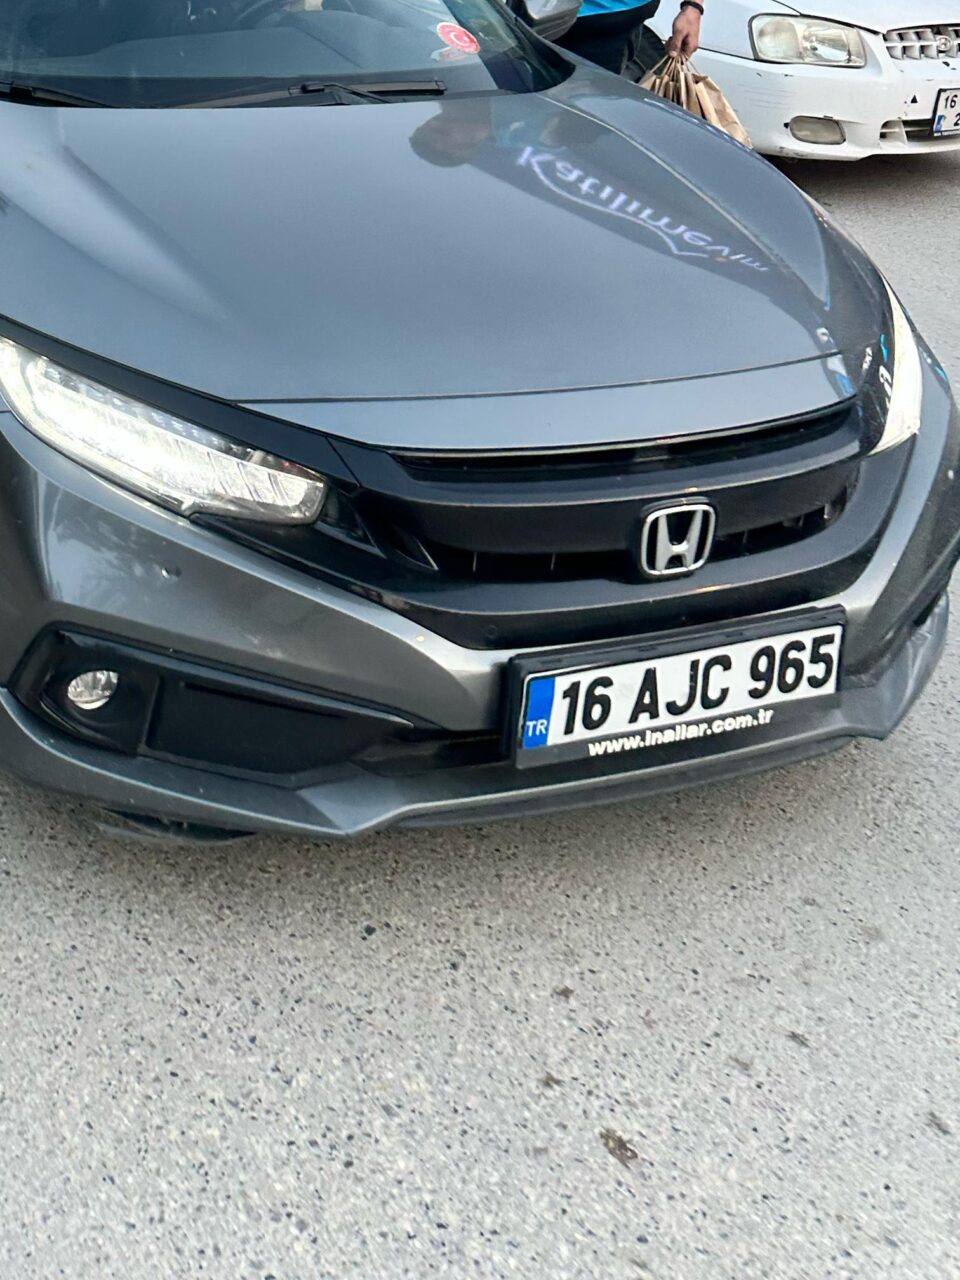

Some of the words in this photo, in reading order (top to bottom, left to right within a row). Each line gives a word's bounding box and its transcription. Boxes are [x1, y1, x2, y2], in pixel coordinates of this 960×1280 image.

[944, 94, 958, 108] 16
[561, 676, 614, 736] 16
[628, 654, 732, 724] AJC
[748, 633, 836, 700] 965
[526, 721, 548, 737] TR
